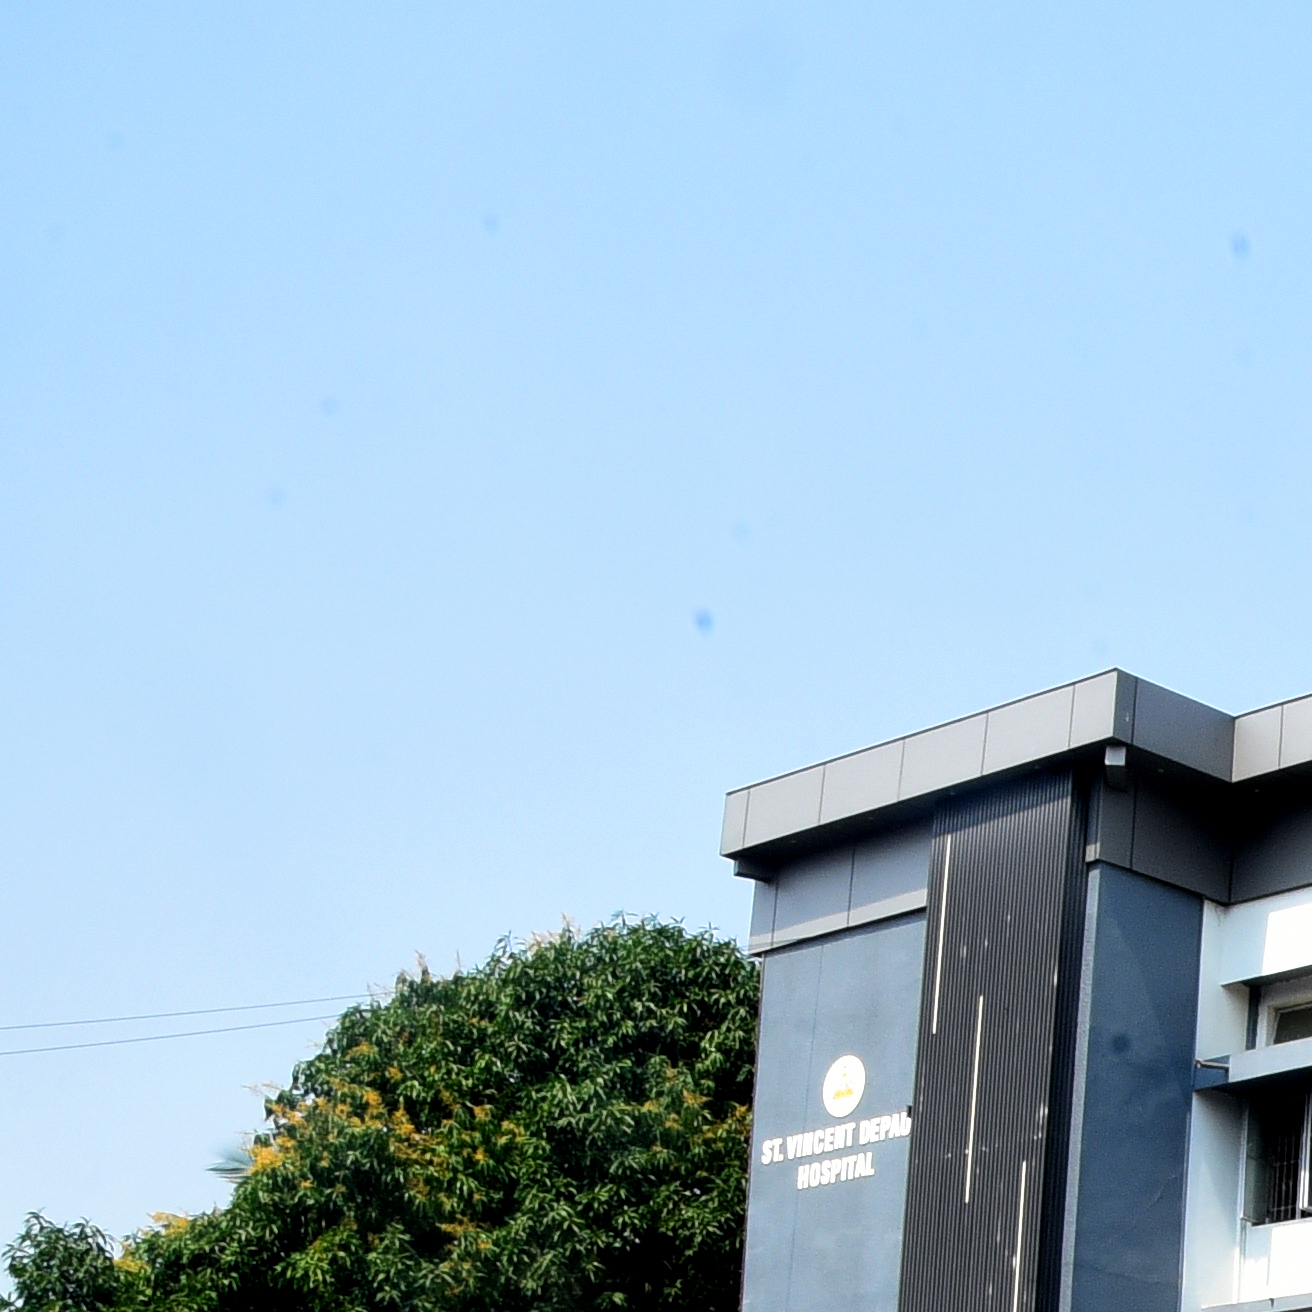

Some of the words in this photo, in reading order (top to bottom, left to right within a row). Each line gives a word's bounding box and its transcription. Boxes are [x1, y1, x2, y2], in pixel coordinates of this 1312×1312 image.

[761, 1138, 785, 1164] ST.
[786, 1121, 856, 1160] VINCENT
[858, 1111, 912, 1146] DEPAU
[797, 1151, 875, 1190] HOSPITAL
